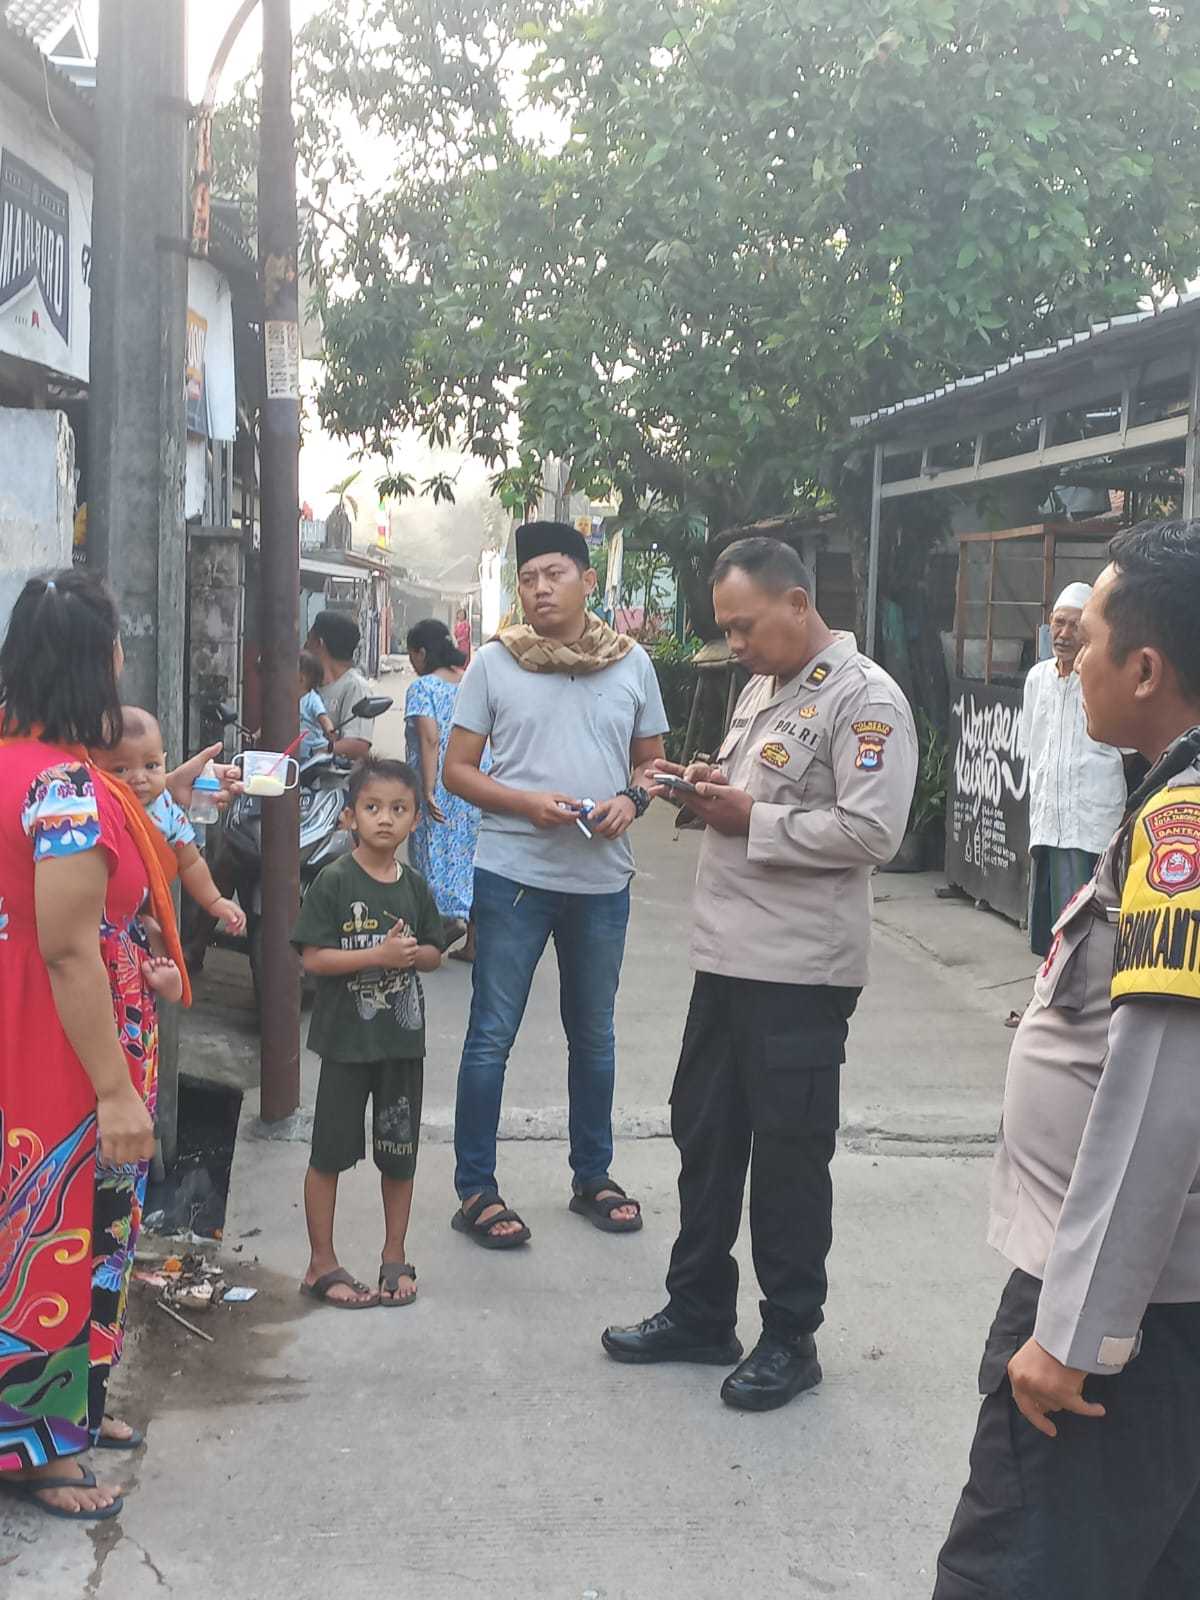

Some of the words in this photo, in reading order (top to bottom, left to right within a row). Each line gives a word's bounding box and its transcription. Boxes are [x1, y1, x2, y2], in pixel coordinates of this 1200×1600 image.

[0, 201, 64, 317] MARLBORO
[774, 719, 818, 746] POLRI
[1112, 906, 1200, 978] BINKAMT
